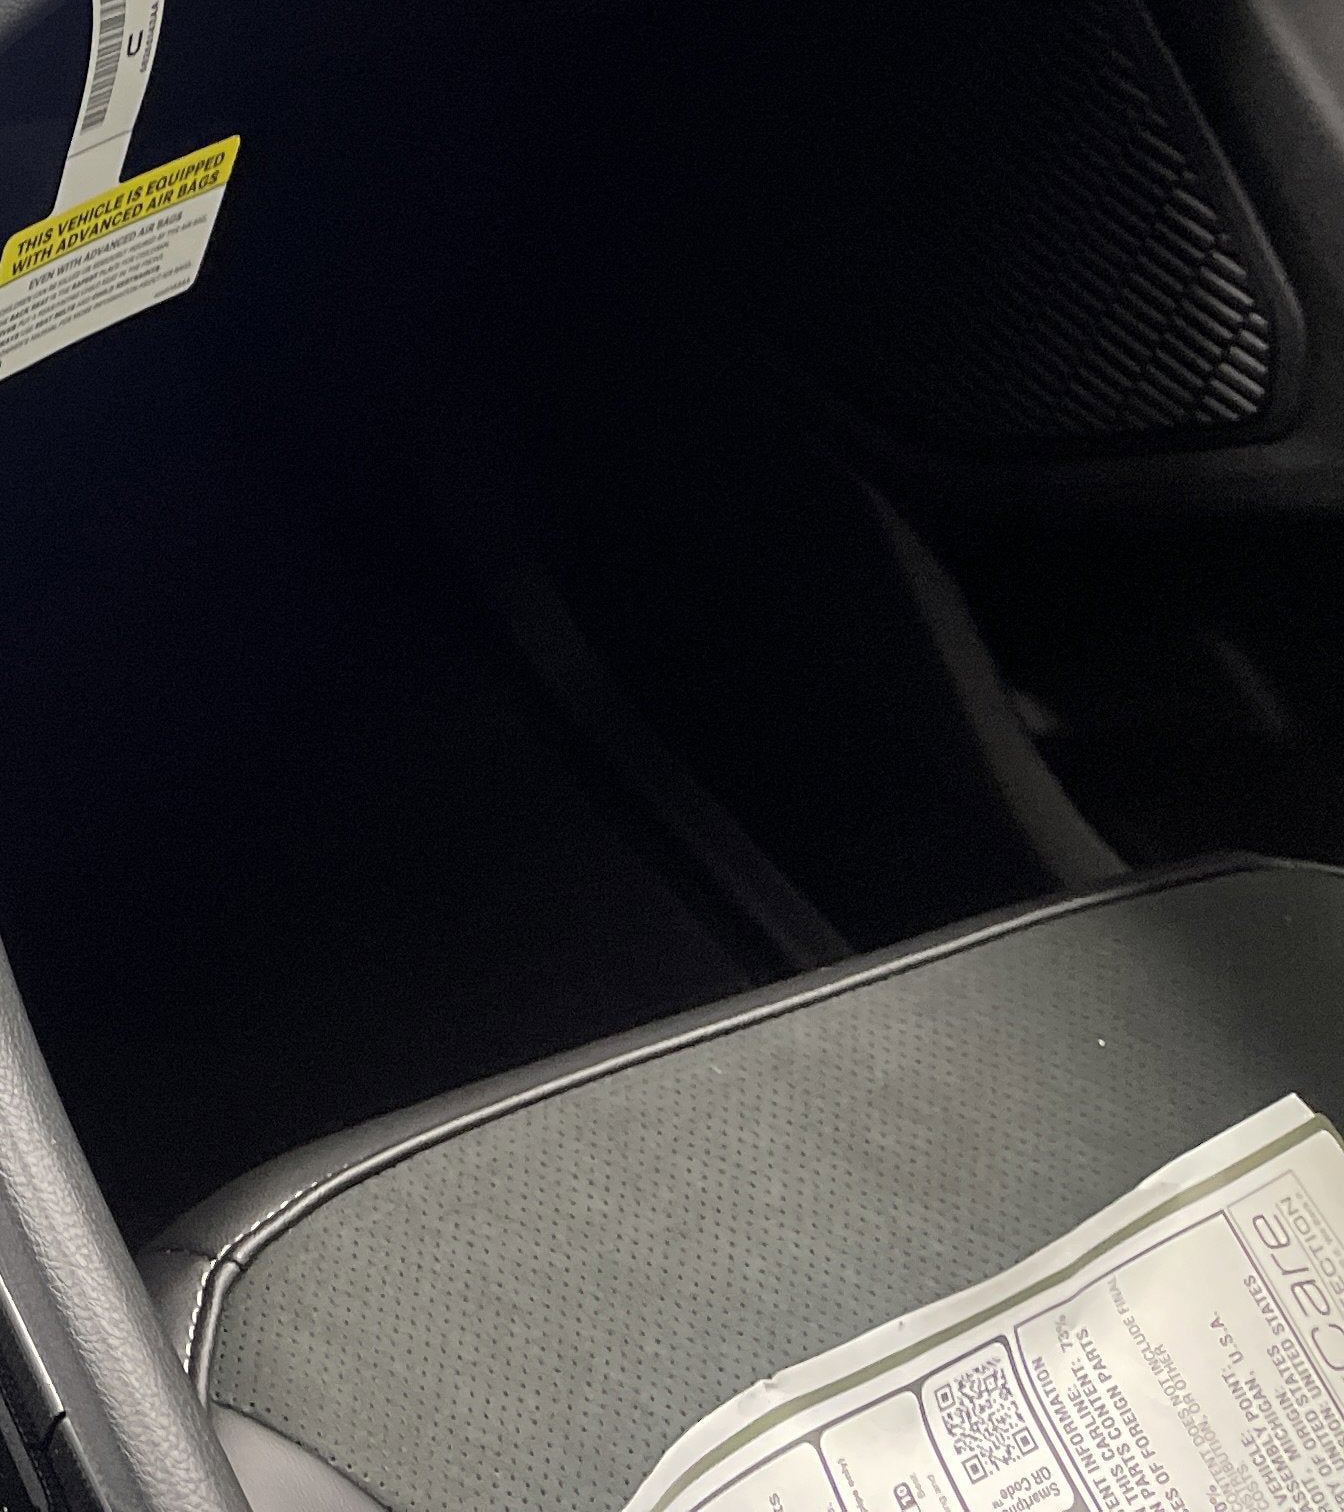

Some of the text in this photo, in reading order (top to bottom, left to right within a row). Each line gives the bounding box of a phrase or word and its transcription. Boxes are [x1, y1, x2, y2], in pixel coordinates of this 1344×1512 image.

[12, 170, 220, 276] WITH ADVANCED AIR BAGS
[17, 151, 226, 257] THIS VEHICLE IS EQUIPPED
[55, 257, 83, 276] WITH
[84, 230, 138, 265] ADVANCED
[1241, 1271, 1286, 1336] STATES
[1074, 1327, 1112, 1382] PARTS
[1122, 1315, 1164, 1376] INCLUDE
[1153, 1342, 1188, 1392] OTHER
[1205, 1308, 1245, 1365] U.S.A.
[1279, 1335, 1323, 1400] UNITED
[1028, 1356, 1100, 1472] INFORMATION
[1051, 1313, 1156, 1500] PARTS CONTENT: 73%
[1105, 1383, 1156, 1459] FOREIGN
[1157, 1374, 1183, 1407] NOT
[1181, 1391, 1201, 1415] OR
[1240, 1369, 1301, 1463] MICHIGAN,
[1264, 1341, 1344, 1472] UNITED STATES
[1272, 1383, 1319, 1452] ORIGIN:
[1064, 1382, 1140, 1505] THIS CARLINE:
[1176, 1406, 1206, 1446] DOES
[1218, 1363, 1314, 1512] ASSEMBLY POINT:
[1029, 1464, 1052, 1486] QR
[1148, 1459, 1171, 1486] OF
[1198, 1446, 1244, 1512] CONTENT
[1238, 1428, 1290, 1506] VEHICLE:
[1310, 1451, 1333, 1478] OF
